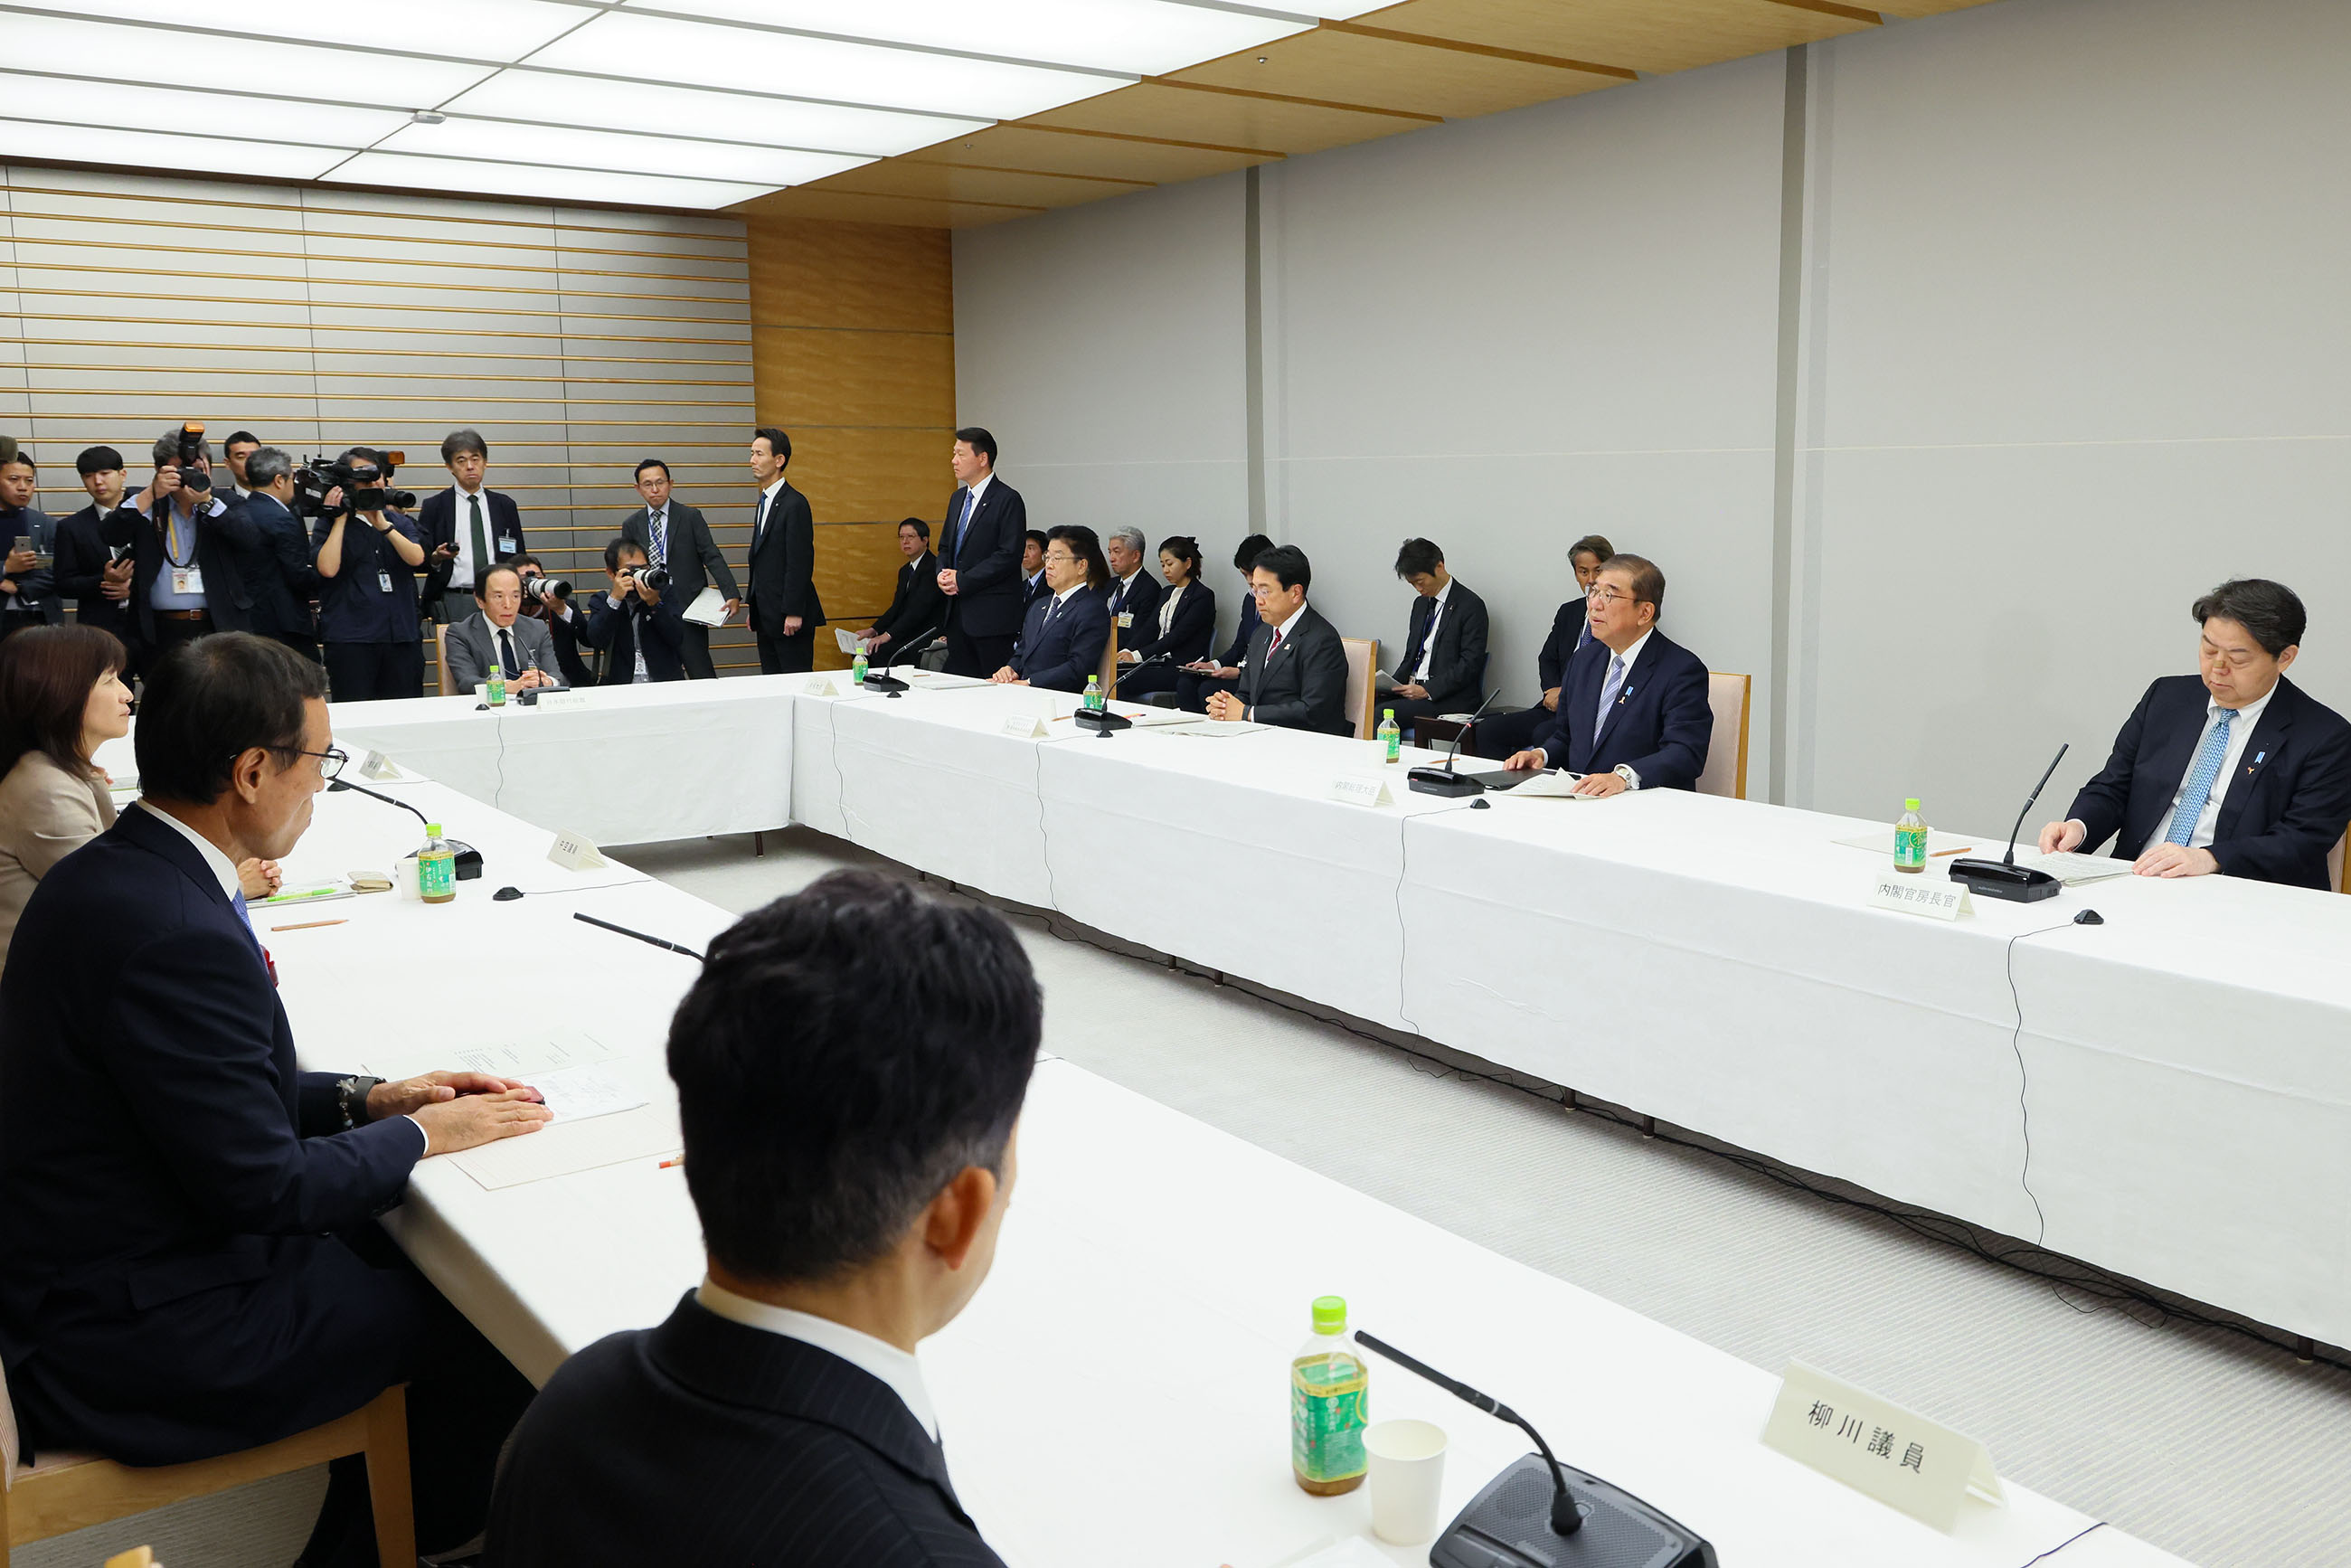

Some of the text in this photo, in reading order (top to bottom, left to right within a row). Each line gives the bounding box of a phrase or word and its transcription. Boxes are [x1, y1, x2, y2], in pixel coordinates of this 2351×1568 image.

[1877, 883, 1957, 908] 内閣官房長官
[1807, 1399, 1925, 1475] 柳川議員
